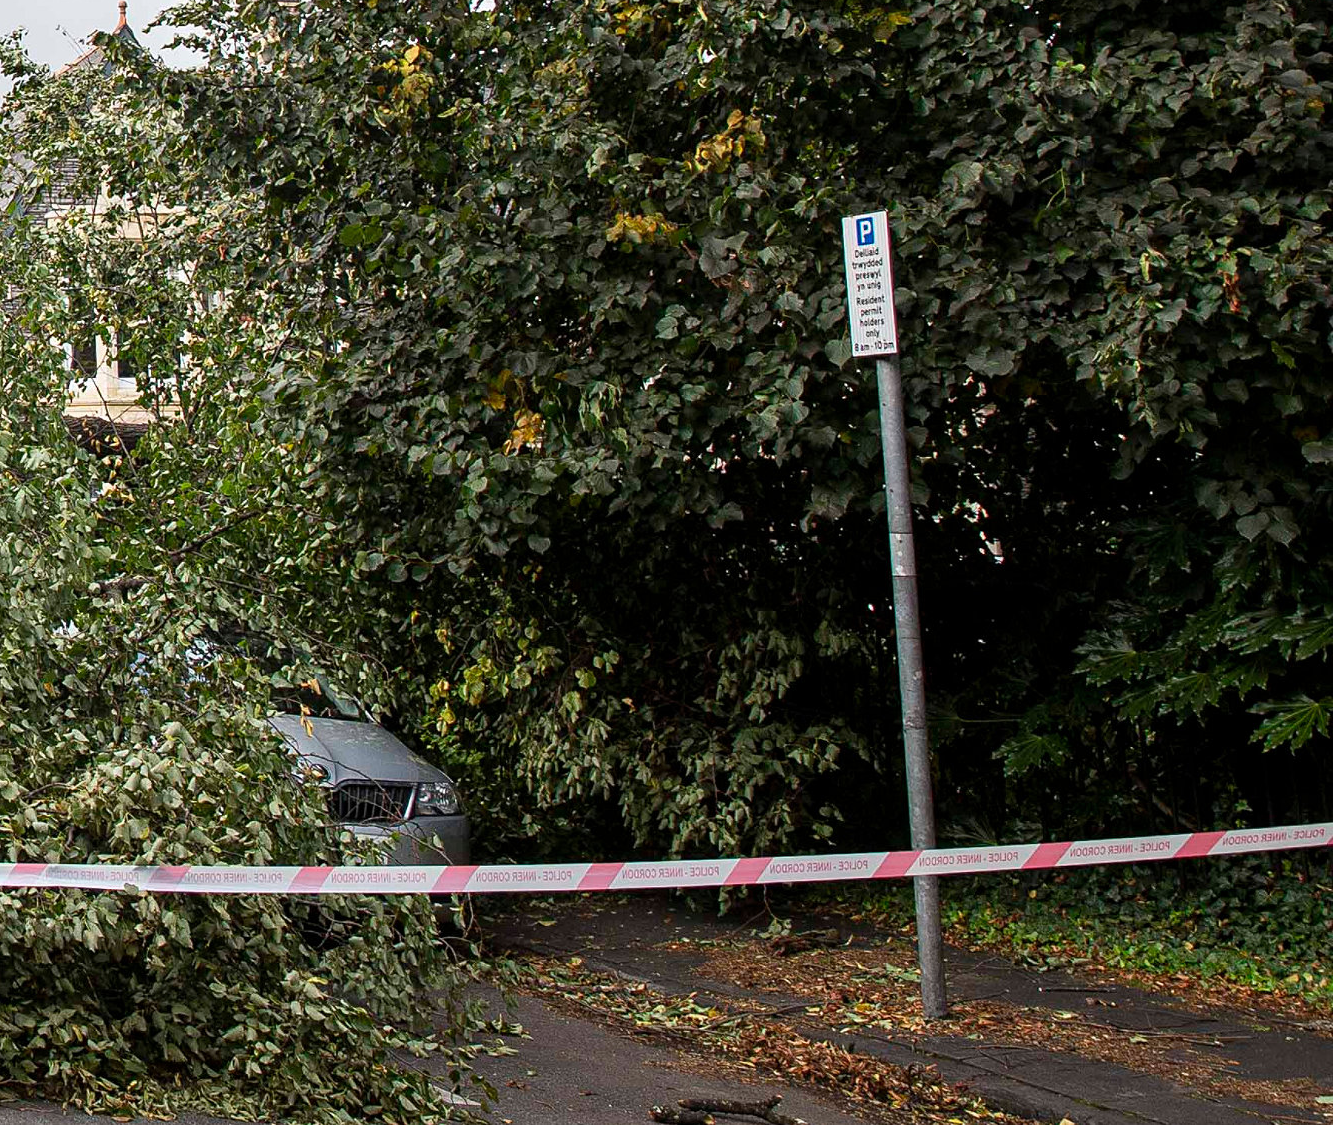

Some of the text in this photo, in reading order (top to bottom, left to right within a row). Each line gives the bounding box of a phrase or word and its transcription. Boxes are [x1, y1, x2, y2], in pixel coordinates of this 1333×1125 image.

[860, 220, 872, 243] P
[852, 258, 883, 270] trwydded
[855, 272, 881, 281] preswyl
[857, 281, 881, 292] yn unig
[856, 295, 885, 305] Resident
[861, 307, 882, 317] permit
[860, 316, 884, 327] holders
[866, 329, 880, 338] only
[875, 342, 882, 350] 10
[883, 340, 894, 351] pm
